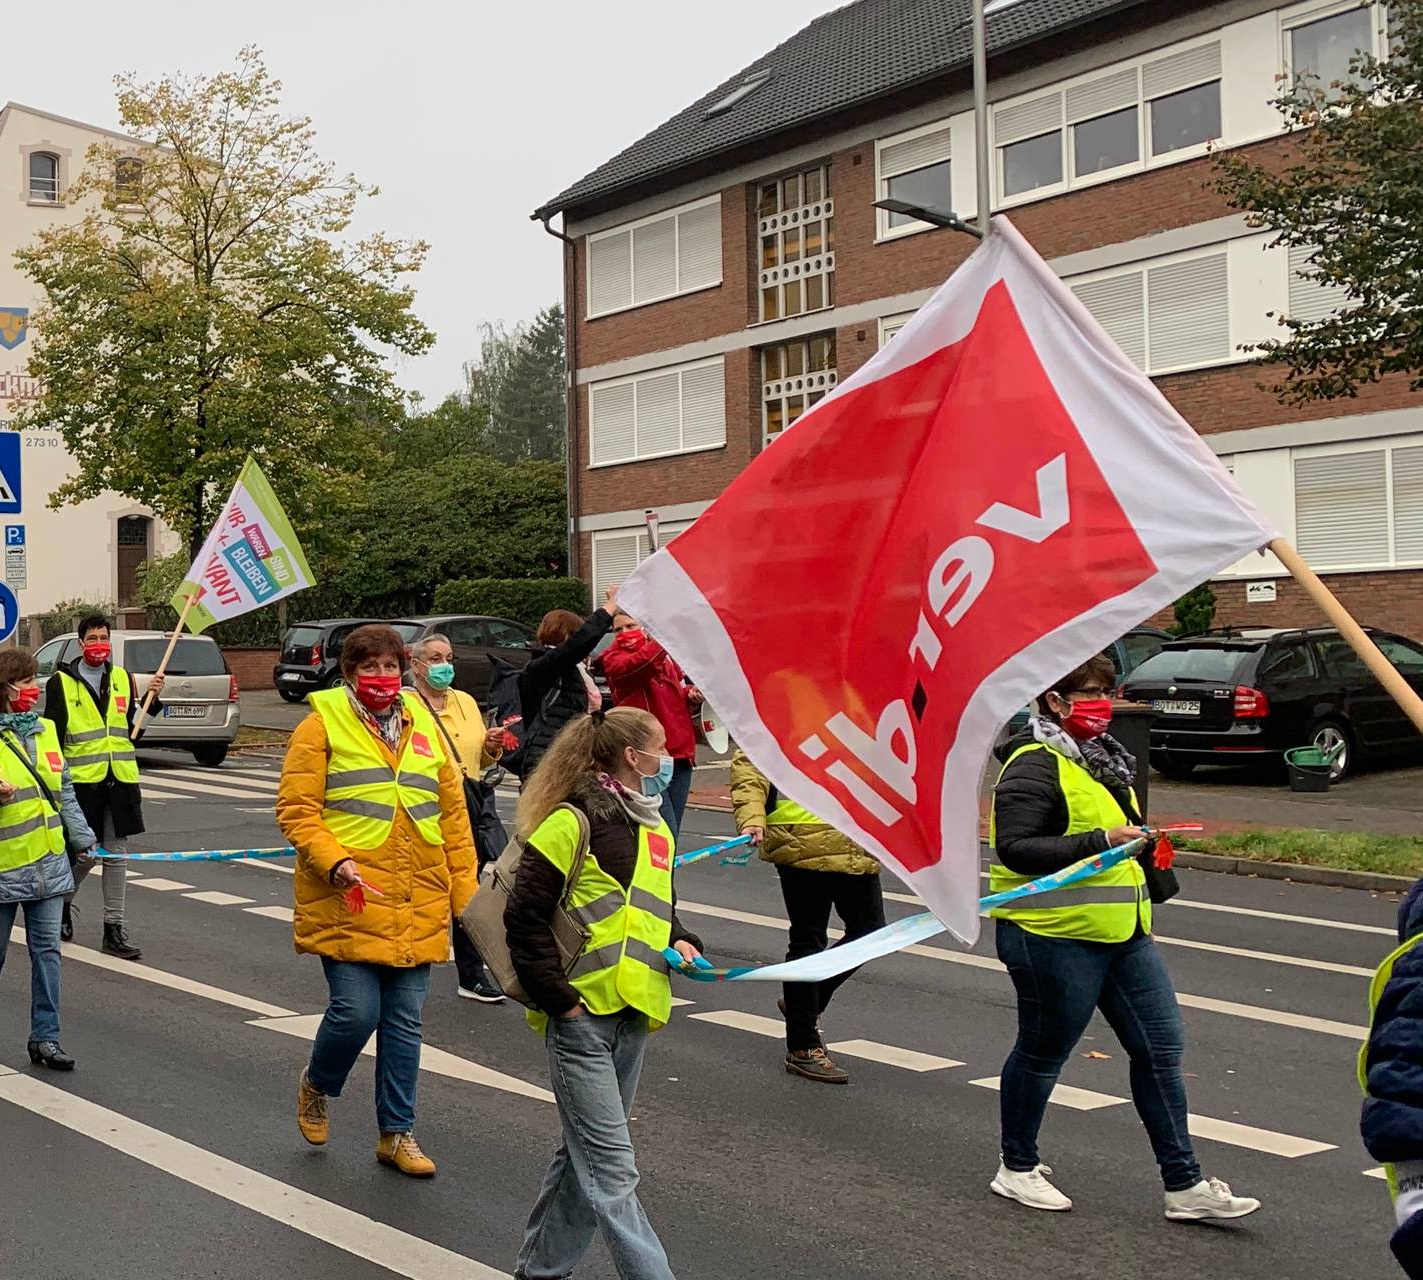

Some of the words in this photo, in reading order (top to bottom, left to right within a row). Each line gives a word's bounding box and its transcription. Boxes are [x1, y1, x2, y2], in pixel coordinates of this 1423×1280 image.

[8, 527, 20, 544] P
[247, 527, 267, 560] WAREN
[231, 547, 272, 596] BLEIBEN
[269, 555, 290, 581] SIND
